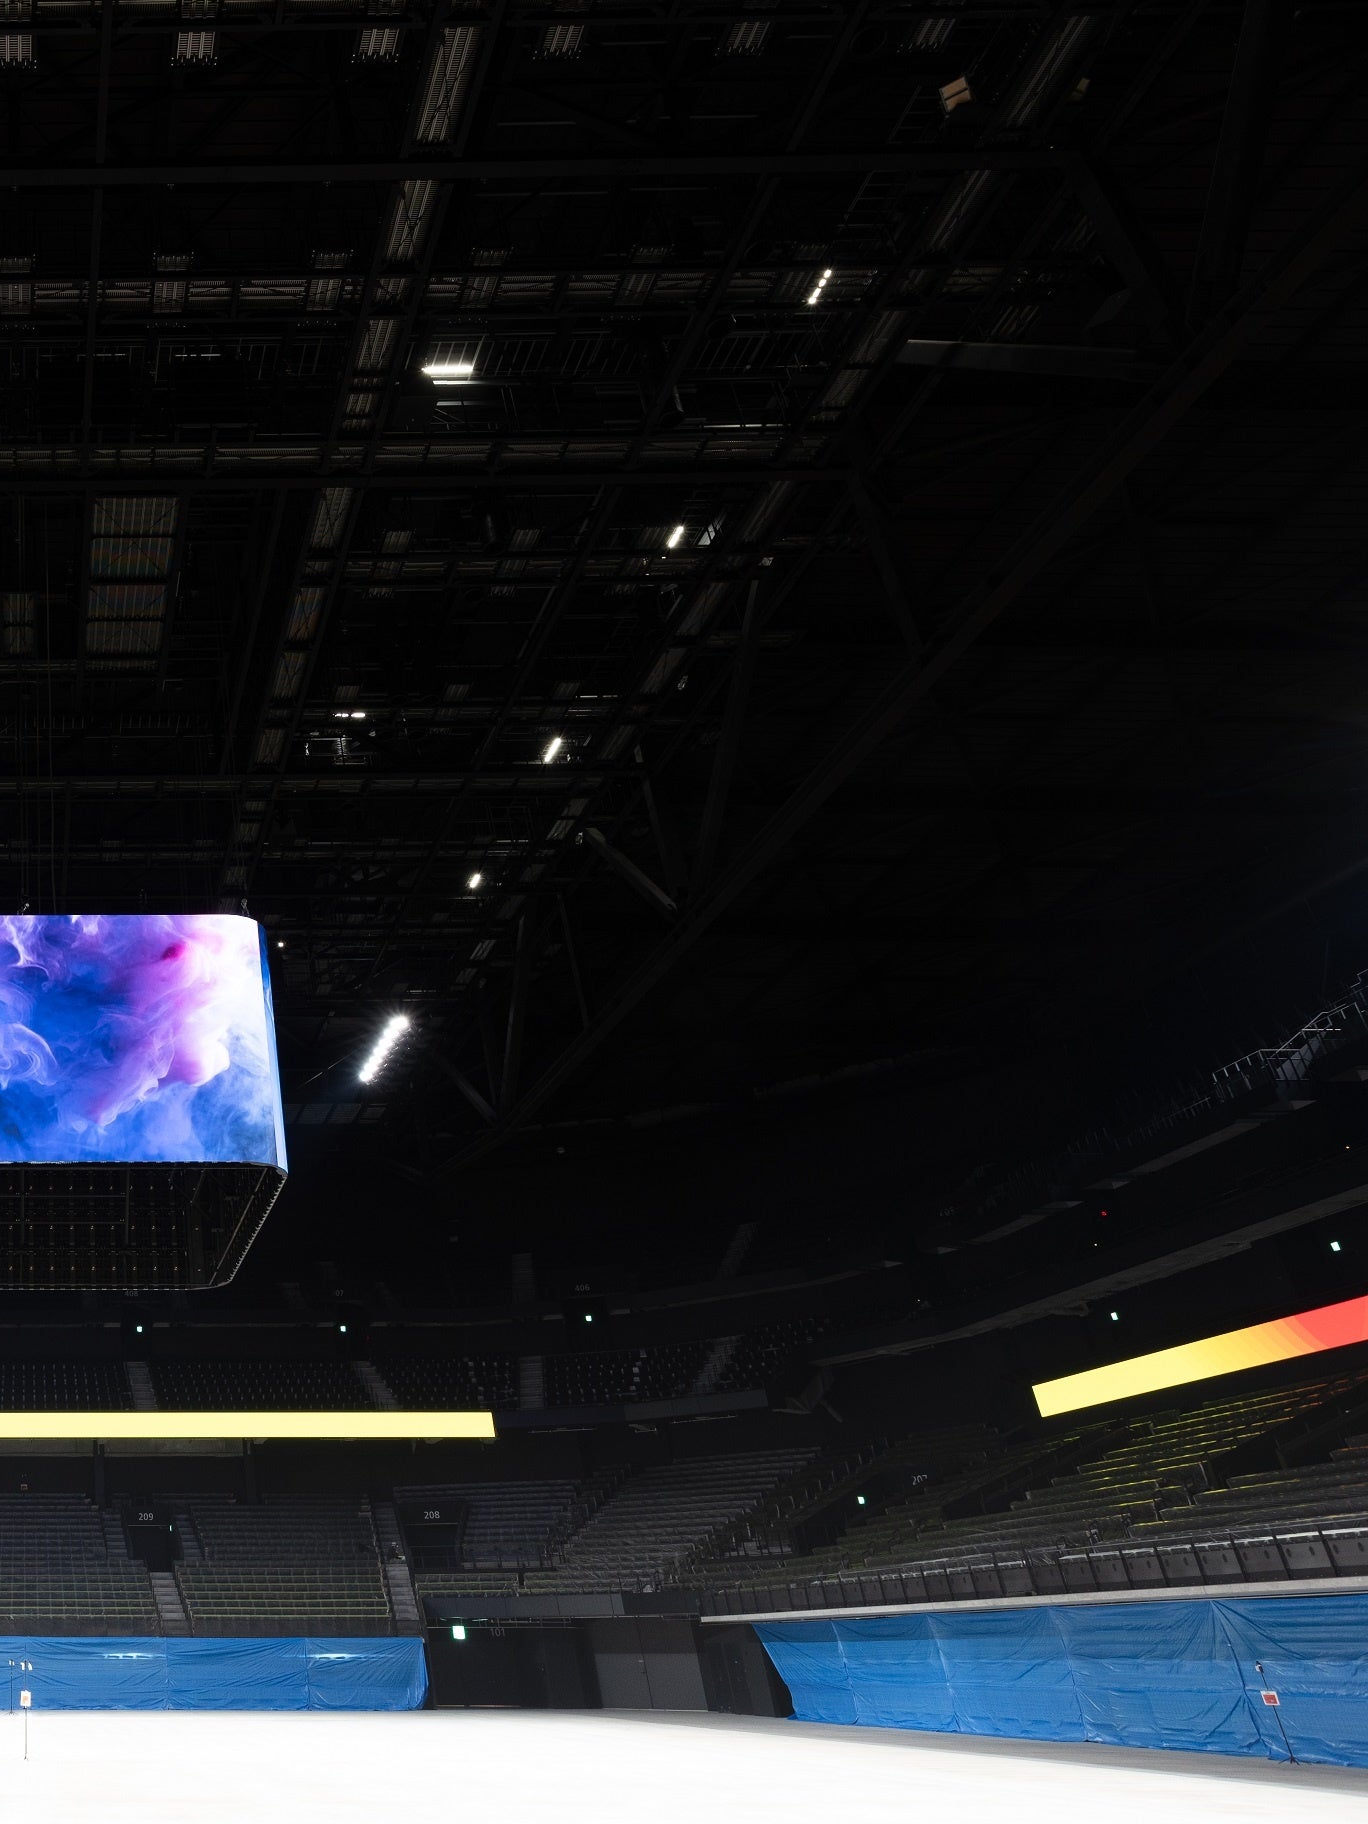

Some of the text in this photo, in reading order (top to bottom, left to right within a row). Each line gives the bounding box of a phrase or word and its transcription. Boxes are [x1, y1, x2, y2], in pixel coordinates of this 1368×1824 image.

[138, 1512, 154, 1521] 209
[423, 1510, 440, 1520] 208
[490, 1627, 506, 1637] 101
